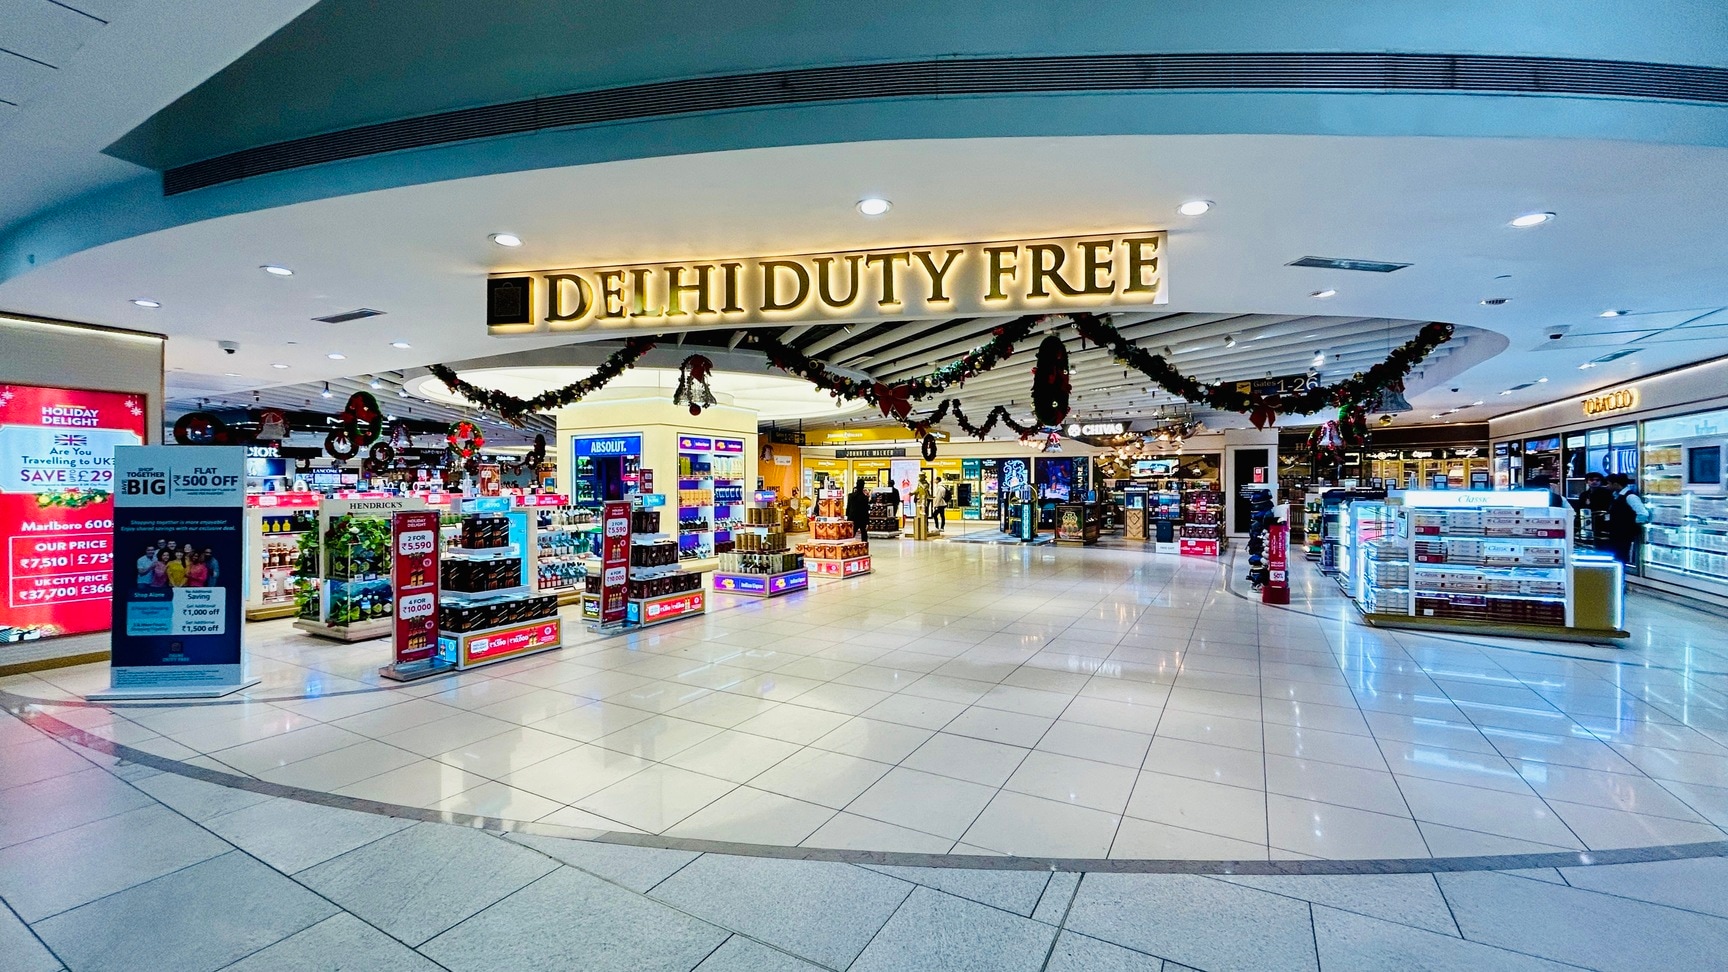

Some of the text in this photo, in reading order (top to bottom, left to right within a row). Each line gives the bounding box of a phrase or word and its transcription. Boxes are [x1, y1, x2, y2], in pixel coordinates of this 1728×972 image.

[544, 236, 1159, 323] DELHI DUTY FREE
[1253, 377, 1318, 393] Gates 1-26
[1581, 389, 1633, 415] TOBACCO
[41, 406, 99, 418] HOLIDAY
[41, 415, 99, 427] DELIGHT
[1082, 423, 1123, 436] CHIVAS
[50, 447, 92, 456] Are You
[21, 455, 76, 467] Travelling
[80, 458, 90, 466] to
[20, 469, 66, 482] SAVE
[194, 467, 217, 475] FLAT
[127, 479, 166, 495] BIG
[173, 475, 238, 487] ₹500 OFF
[350, 502, 403, 510] HENDRICK'S
[21, 520, 82, 532] Marlboro
[35, 539, 107, 552] OUR PRICE
[34, 574, 109, 587] UK CITY PRICE
[19, 586, 76, 600] ₹37,700
[187, 593, 211, 601] Saving
